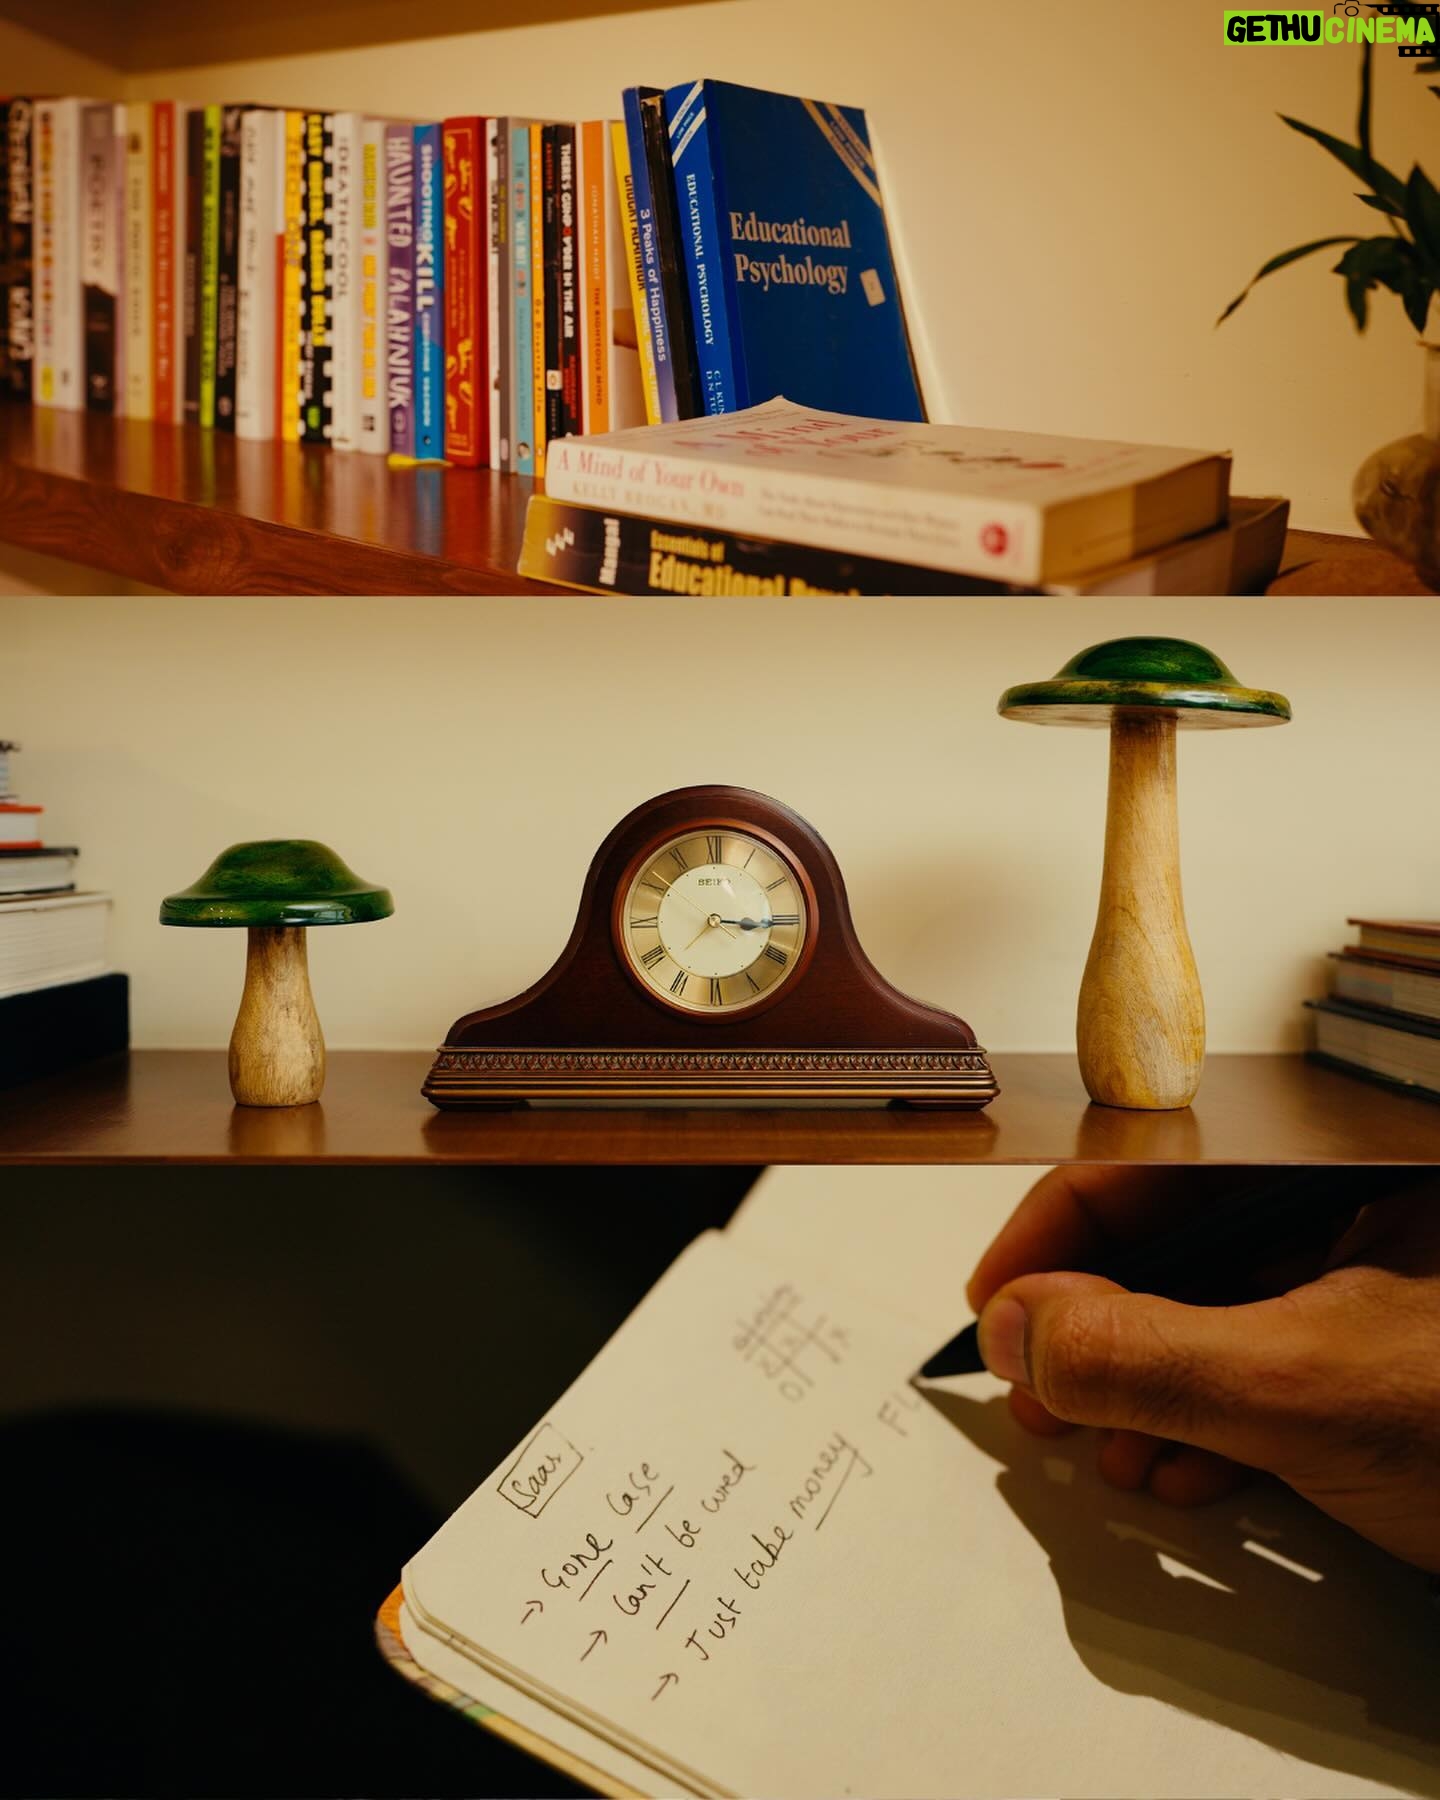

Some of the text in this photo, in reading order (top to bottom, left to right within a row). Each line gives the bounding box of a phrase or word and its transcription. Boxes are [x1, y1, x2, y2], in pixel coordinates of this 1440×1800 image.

[386, 136, 414, 248] HAUNTED
[420, 143, 434, 242] SHOOTING
[591, 184, 600, 245] JONATHAN
[640, 208, 651, 220] 3
[560, 143, 574, 338] THERE'S GUNPOWDER IN THE AIR
[643, 223, 656, 264] Peaks
[729, 211, 851, 248] Educational
[415, 242, 435, 312] KILL
[648, 268, 660, 284] of
[686, 173, 714, 345] EDUCATIONAL PSYCHOLOGY
[734, 253, 848, 294] Psychology
[387, 267, 413, 409] PALAHNIUK
[594, 287, 604, 406] THE RIGHTEOUS MIND
[650, 287, 668, 362] Happiness
[556, 449, 745, 497] A Mind of Your Own
[650, 529, 725, 562] Essentials of
[648, 551, 786, 596] Educational
[697, 878, 731, 887] SEIK
[664, 1519, 701, 1549] be
[734, 1525, 794, 1590] take
[789, 1432, 875, 1520] money
